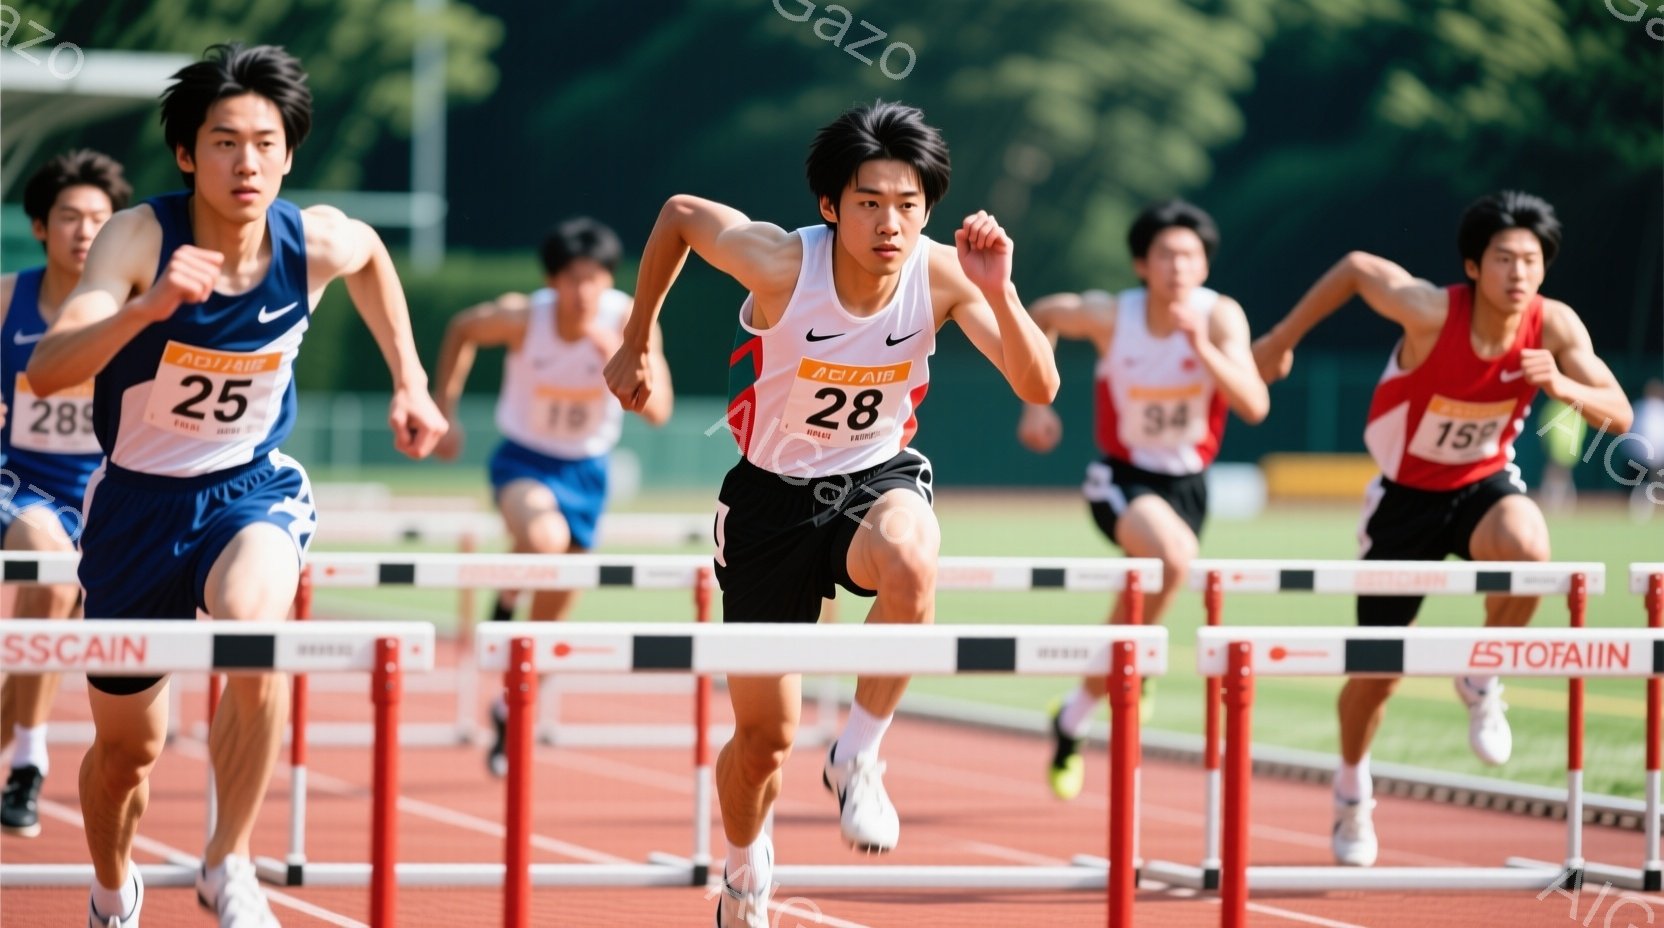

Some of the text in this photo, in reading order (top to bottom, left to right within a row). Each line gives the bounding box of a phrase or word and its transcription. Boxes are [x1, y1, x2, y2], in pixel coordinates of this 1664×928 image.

[170, 374, 253, 423] 25
[805, 387, 884, 431] 28
[3, 632, 147, 665] SSCAIN
